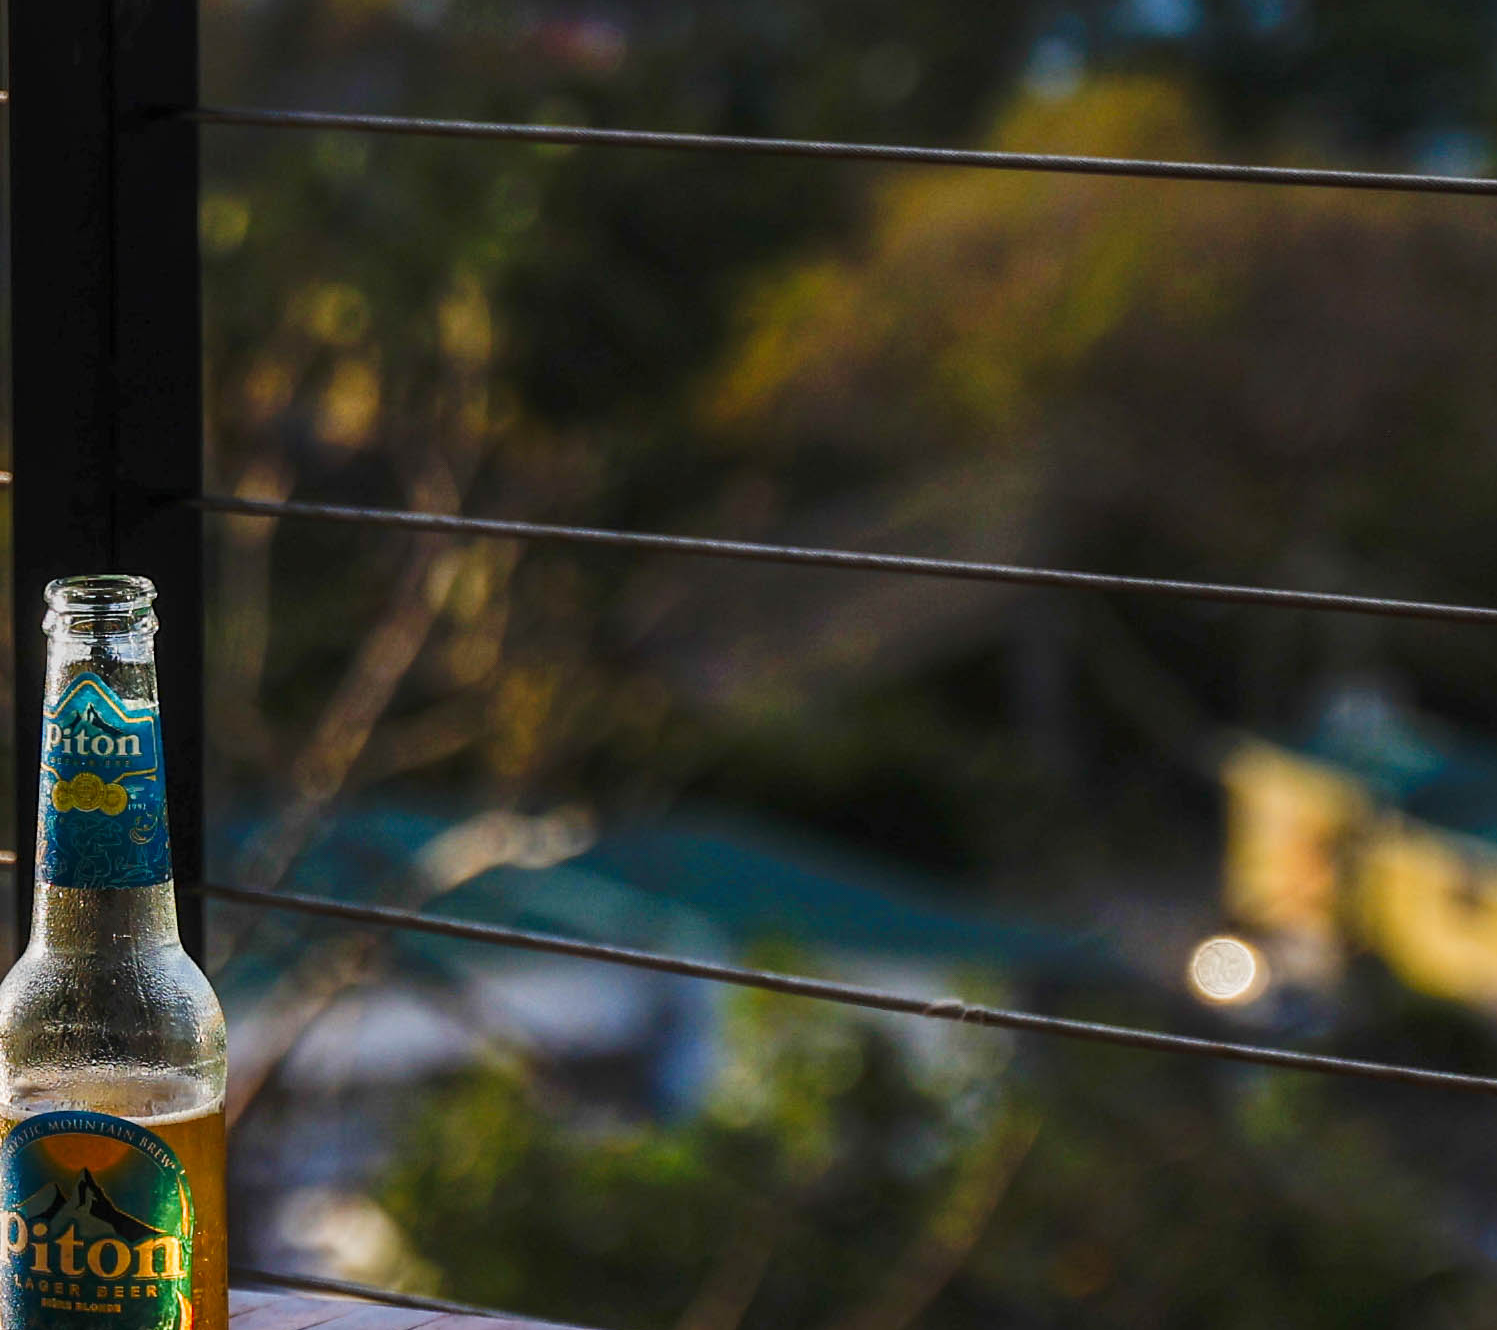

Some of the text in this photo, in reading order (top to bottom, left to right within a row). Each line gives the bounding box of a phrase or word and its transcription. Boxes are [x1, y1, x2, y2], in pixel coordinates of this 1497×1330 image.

[46, 724, 142, 756] Piton
[7, 1118, 174, 1169] MYSTIC MOUNTAIN BREW
[0, 1210, 187, 1279] Piton
[13, 1274, 158, 1300] LAGER BEER
